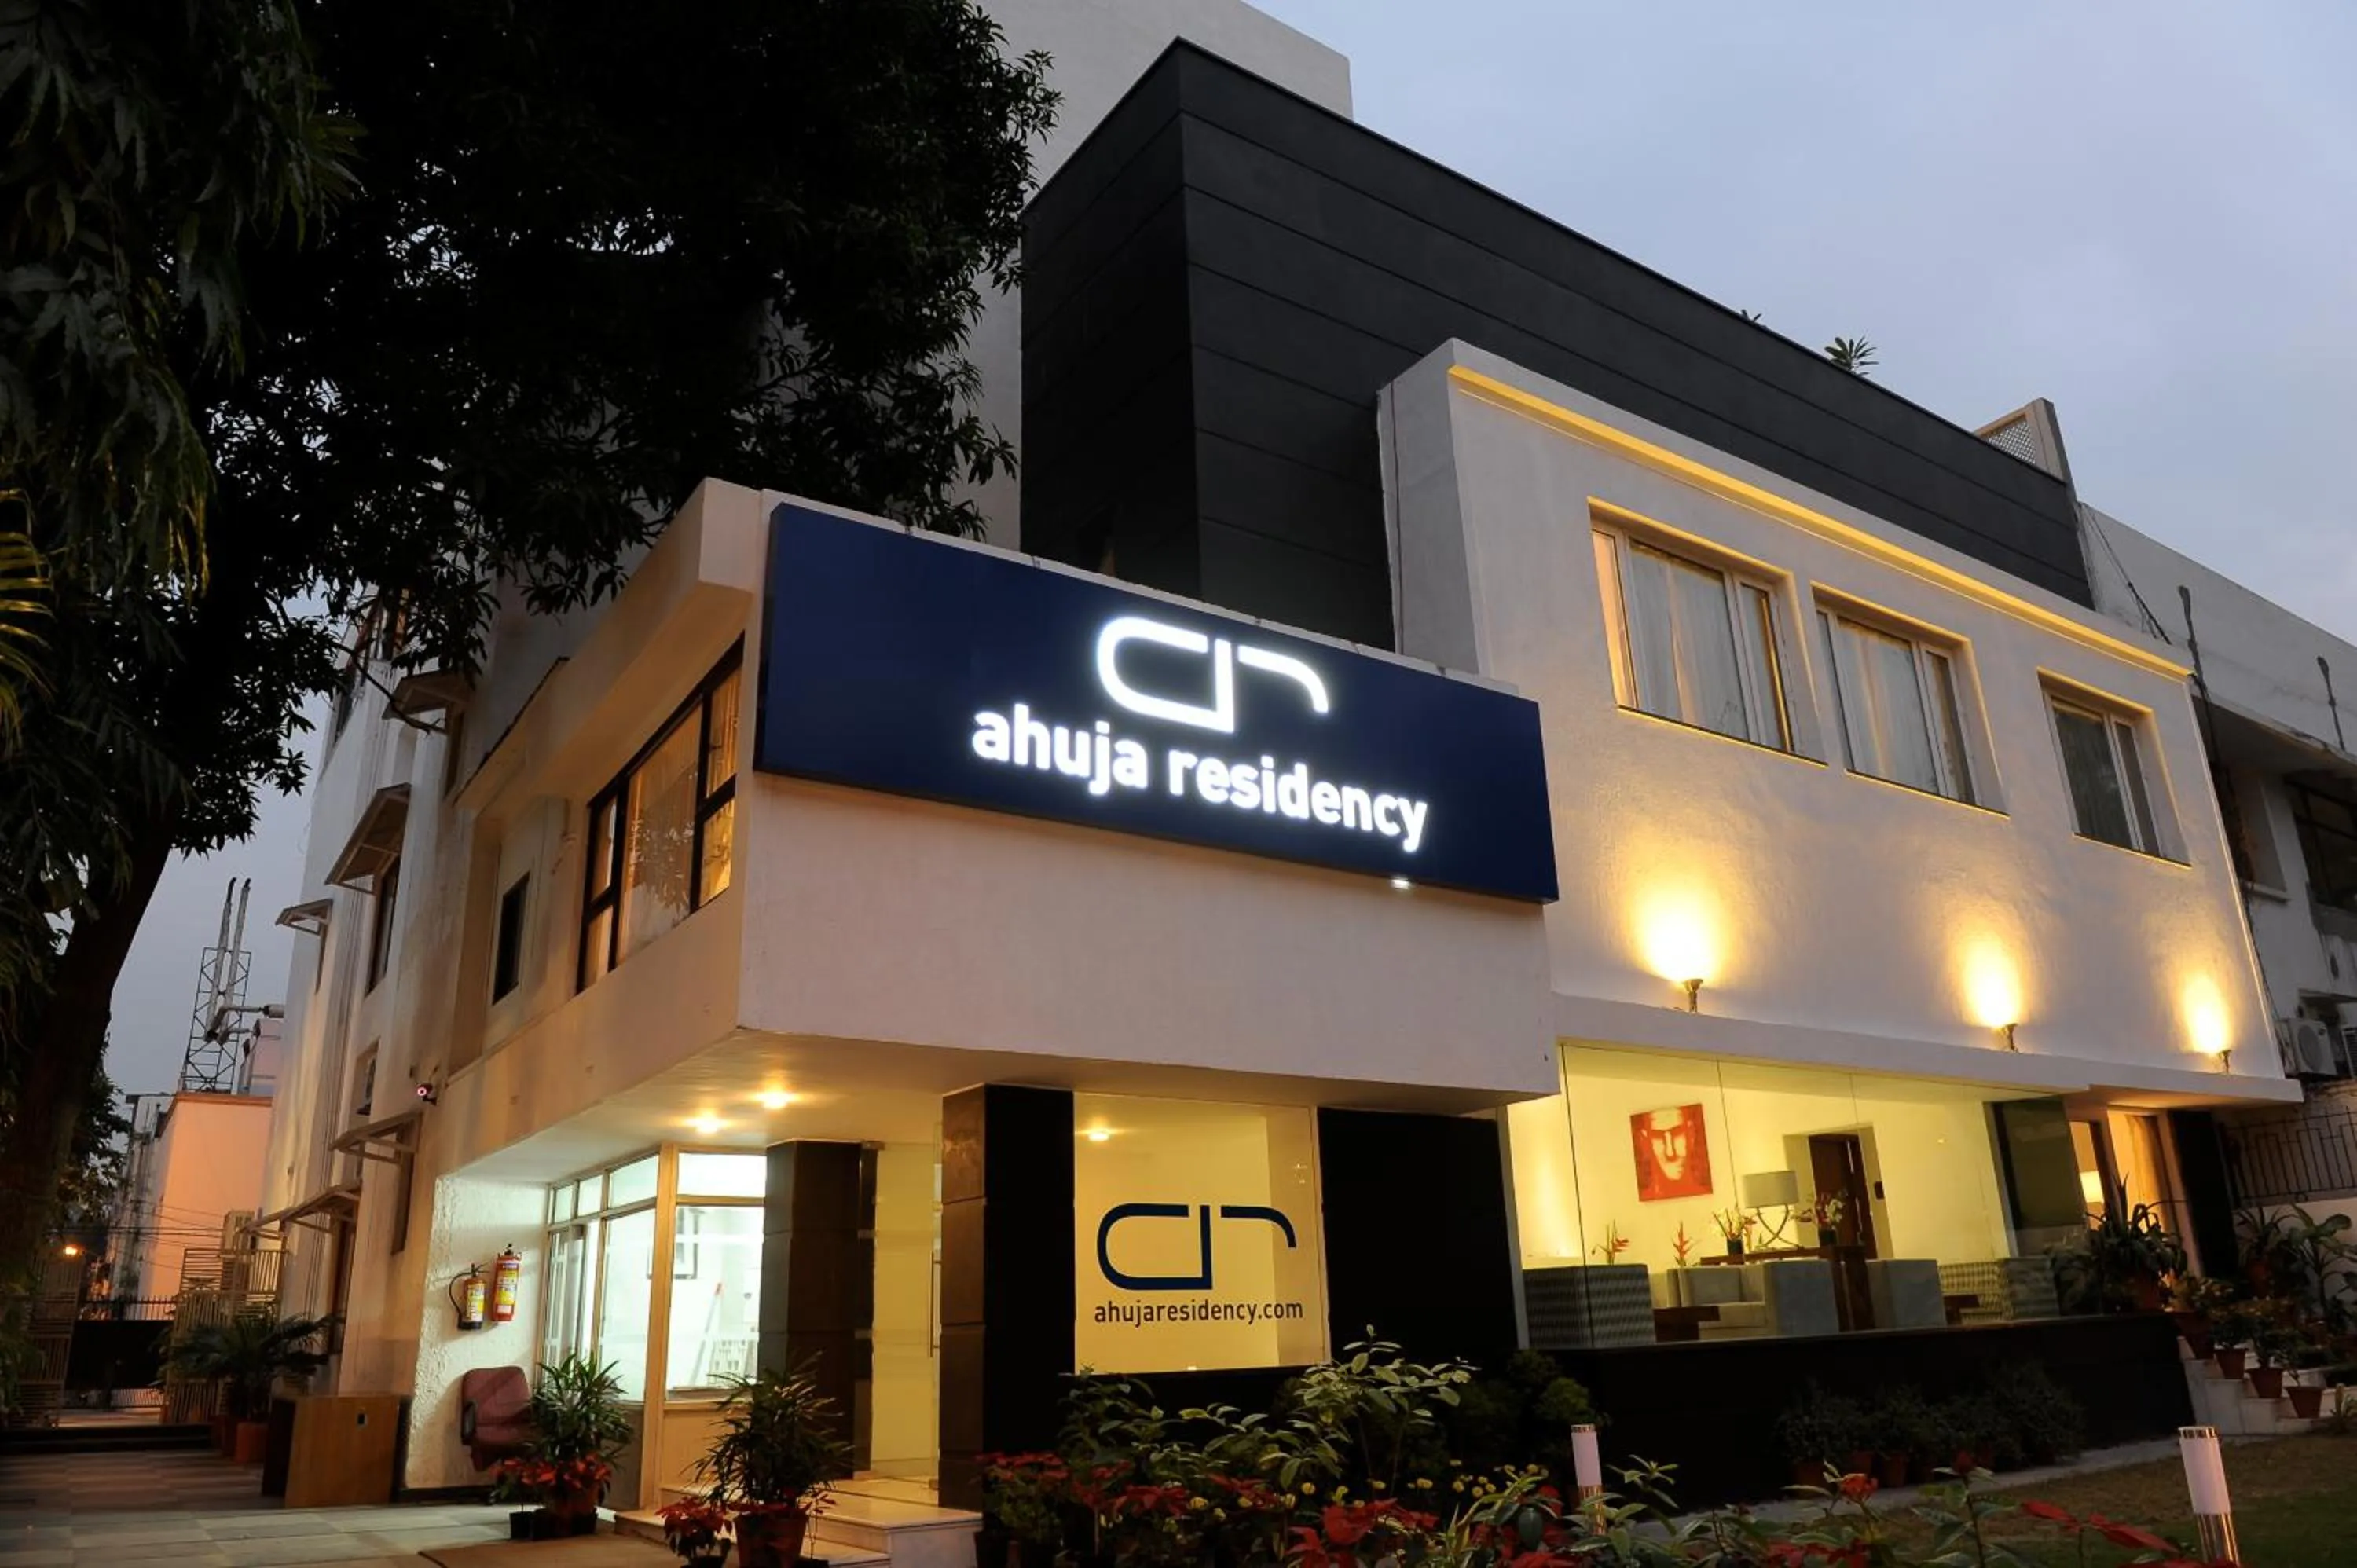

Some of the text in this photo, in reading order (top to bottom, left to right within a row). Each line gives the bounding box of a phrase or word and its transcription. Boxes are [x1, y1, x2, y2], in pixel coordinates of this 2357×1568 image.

[973, 704, 1427, 852] ahuja residency
[1094, 1299, 1303, 1328] ahujaresidency.com
